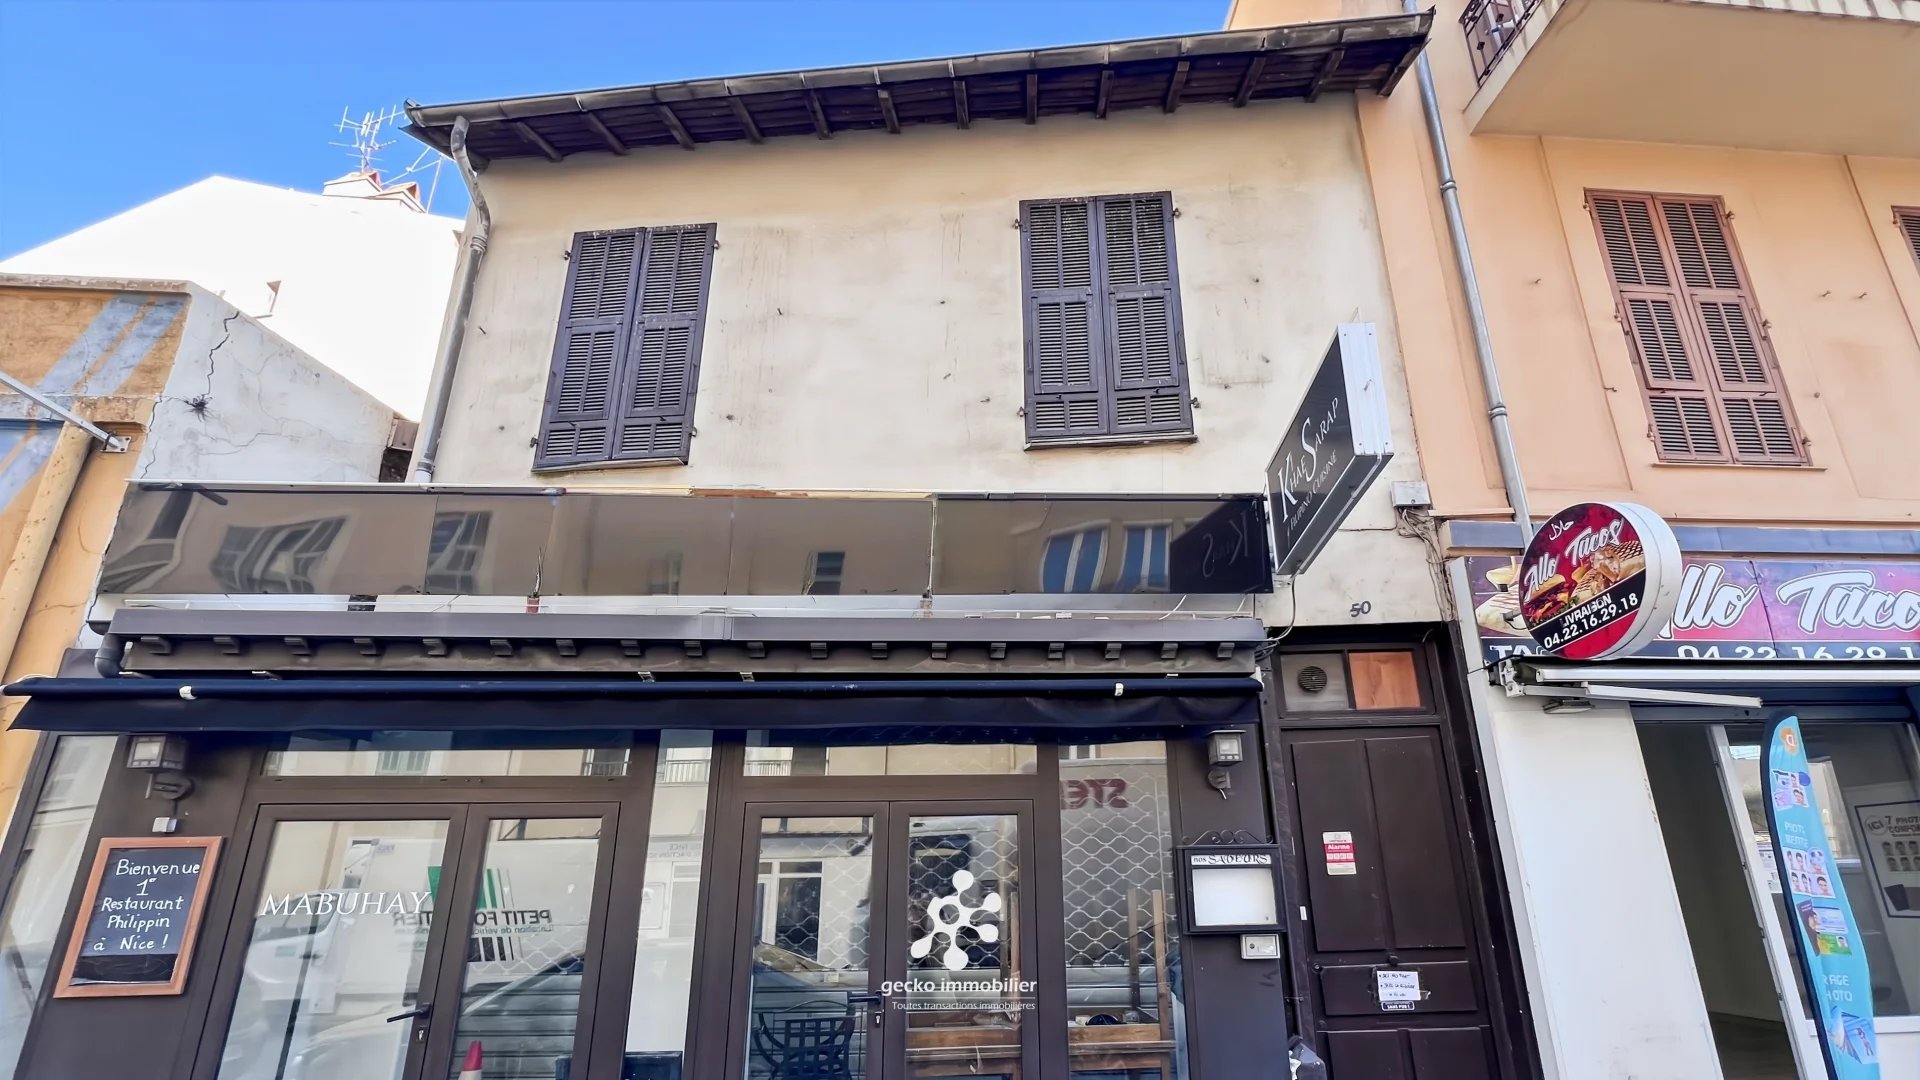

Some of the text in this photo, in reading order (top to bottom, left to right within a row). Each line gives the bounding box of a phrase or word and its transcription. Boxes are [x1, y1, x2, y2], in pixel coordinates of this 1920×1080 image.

[1302, 397, 1339, 482] SARAP
[1524, 517, 1625, 603] Allo Tacos
[1350, 600, 1372, 618] 50
[1658, 563, 1760, 639] llo
[1544, 592, 1638, 649] 04.22.16.29.18
[115, 858, 200, 876] Bienvenue
[101, 895, 185, 912] Restaurant
[259, 890, 432, 917] MABUHAY
[106, 912, 170, 933] Philippin
[120, 934, 155, 950] Nice
